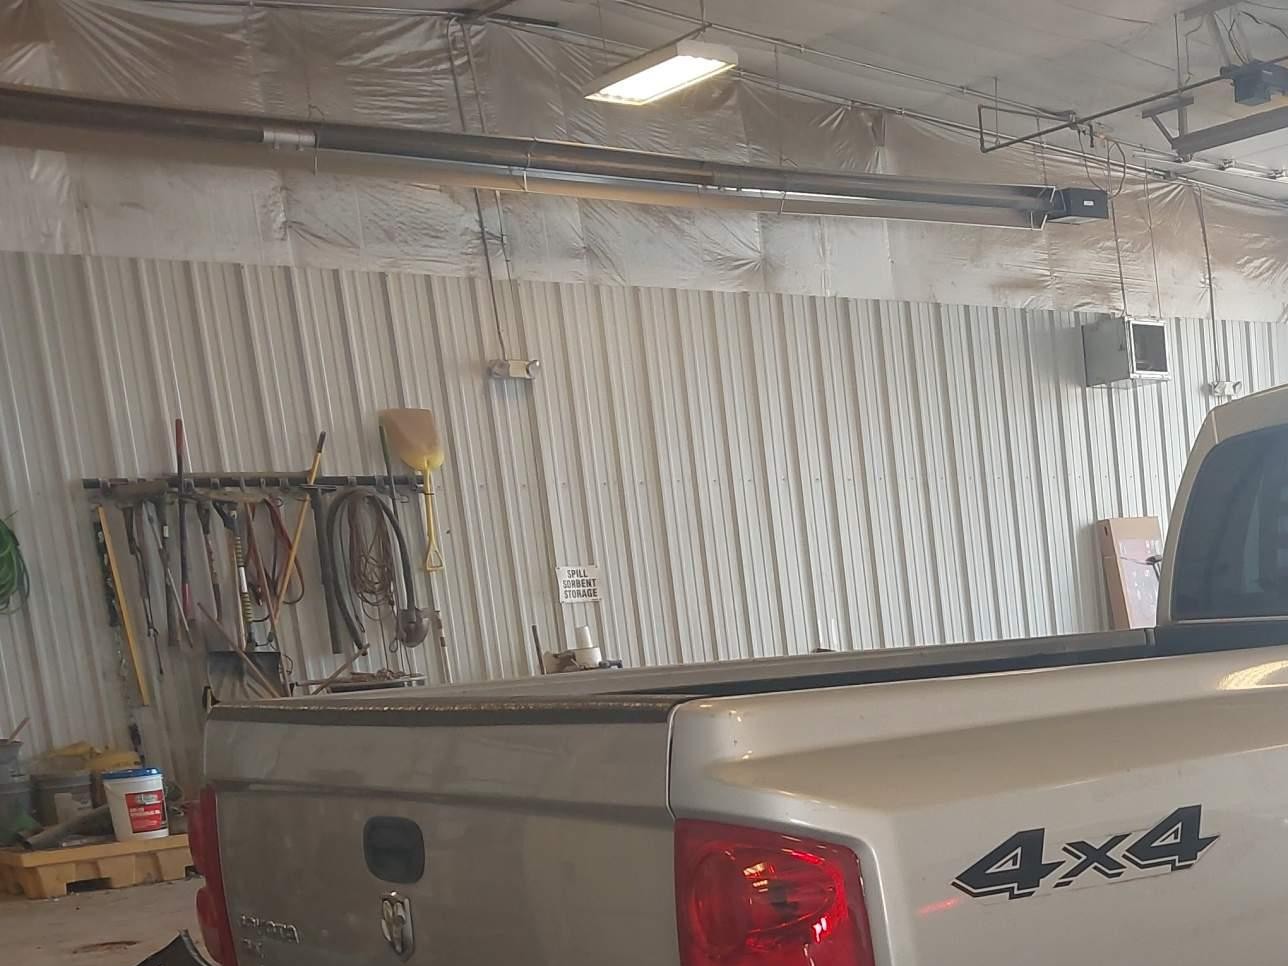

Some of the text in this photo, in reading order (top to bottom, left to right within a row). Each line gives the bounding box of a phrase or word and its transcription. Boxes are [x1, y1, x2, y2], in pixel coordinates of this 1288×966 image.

[567, 569, 588, 579] SPILL
[563, 578, 597, 588] SORBENT
[564, 588, 598, 599] STORAGE
